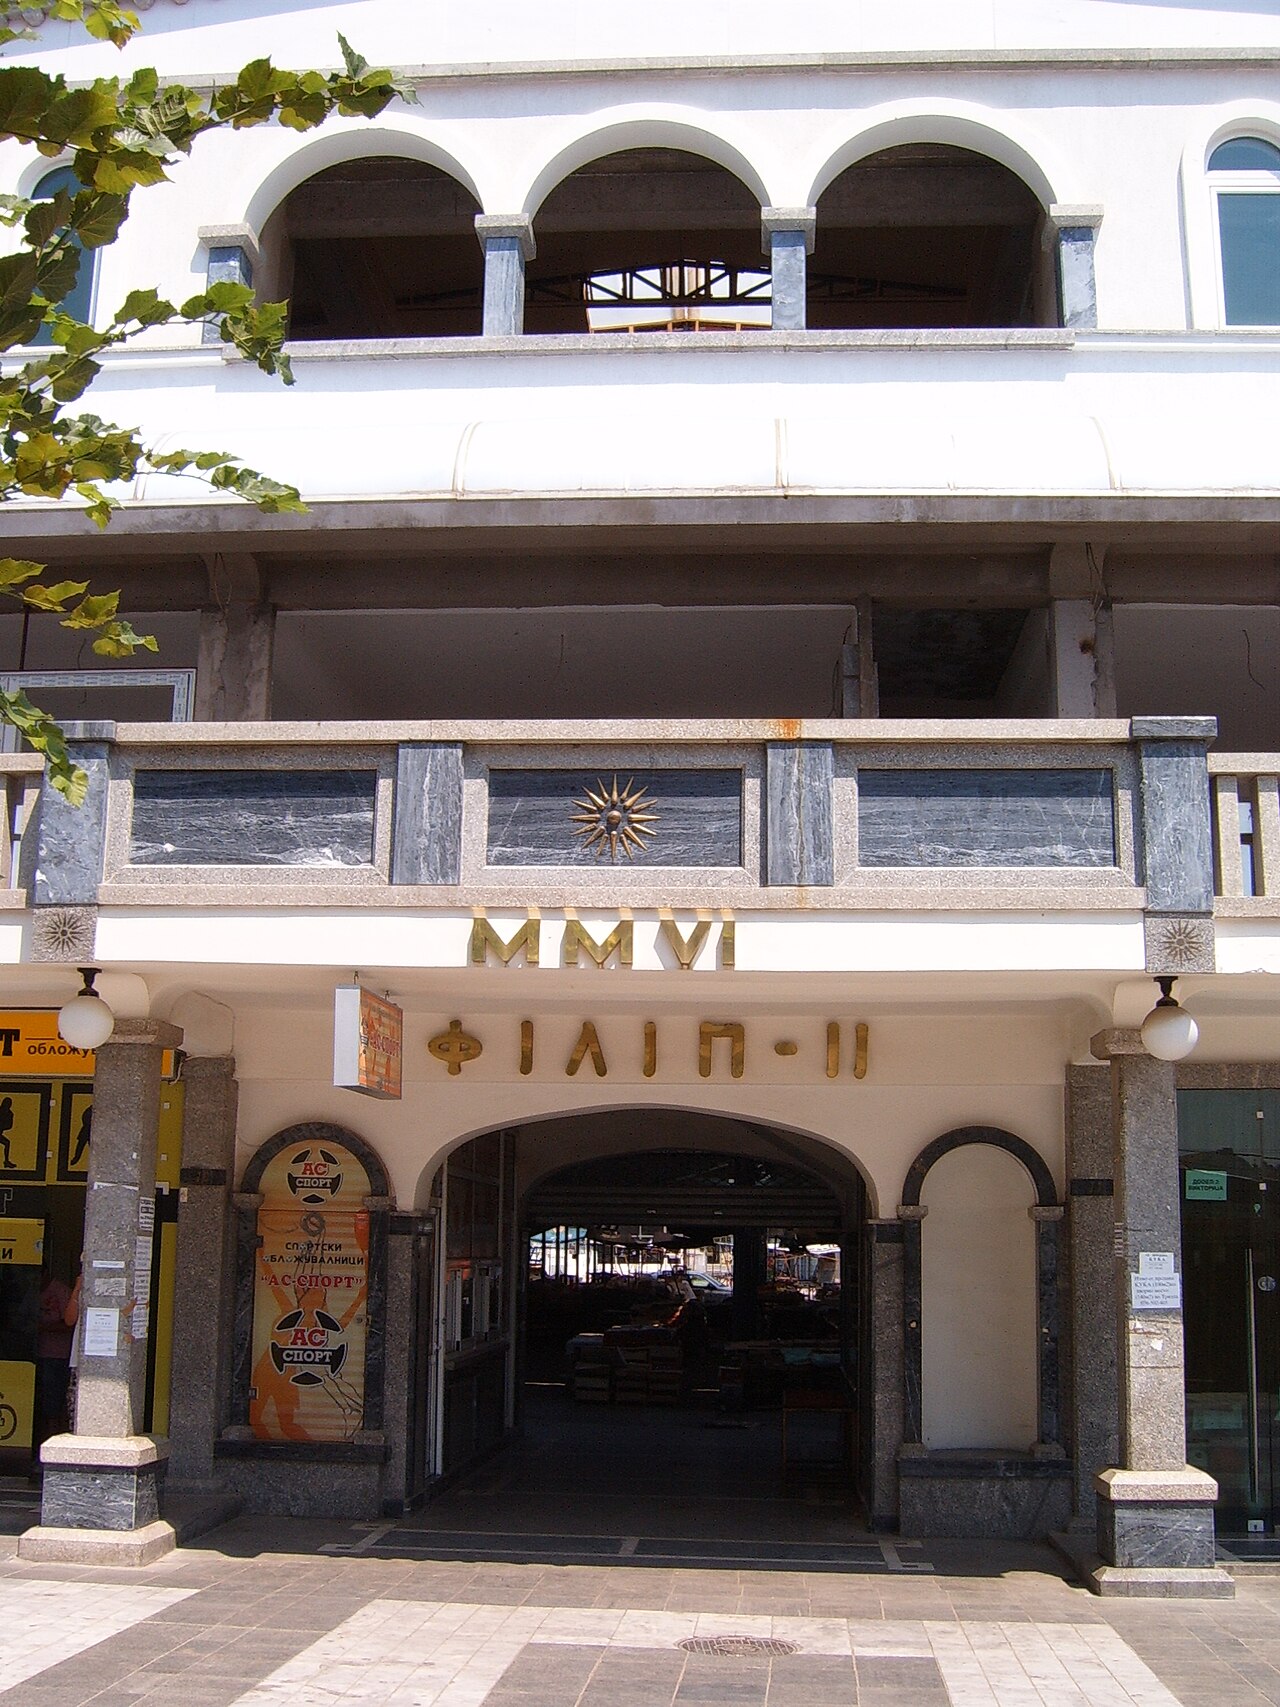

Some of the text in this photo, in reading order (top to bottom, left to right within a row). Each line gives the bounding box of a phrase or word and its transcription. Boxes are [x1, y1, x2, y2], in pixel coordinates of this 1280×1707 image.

[472, 919, 735, 968] MMVI
[301, 1162, 329, 1176] АС
[295, 1178, 332, 1187] СПОРТ
[285, 1242, 342, 1252] СПОРТСКИ
[290, 1327, 328, 1346] АС
[282, 1350, 332, 1363] СПОРТ
